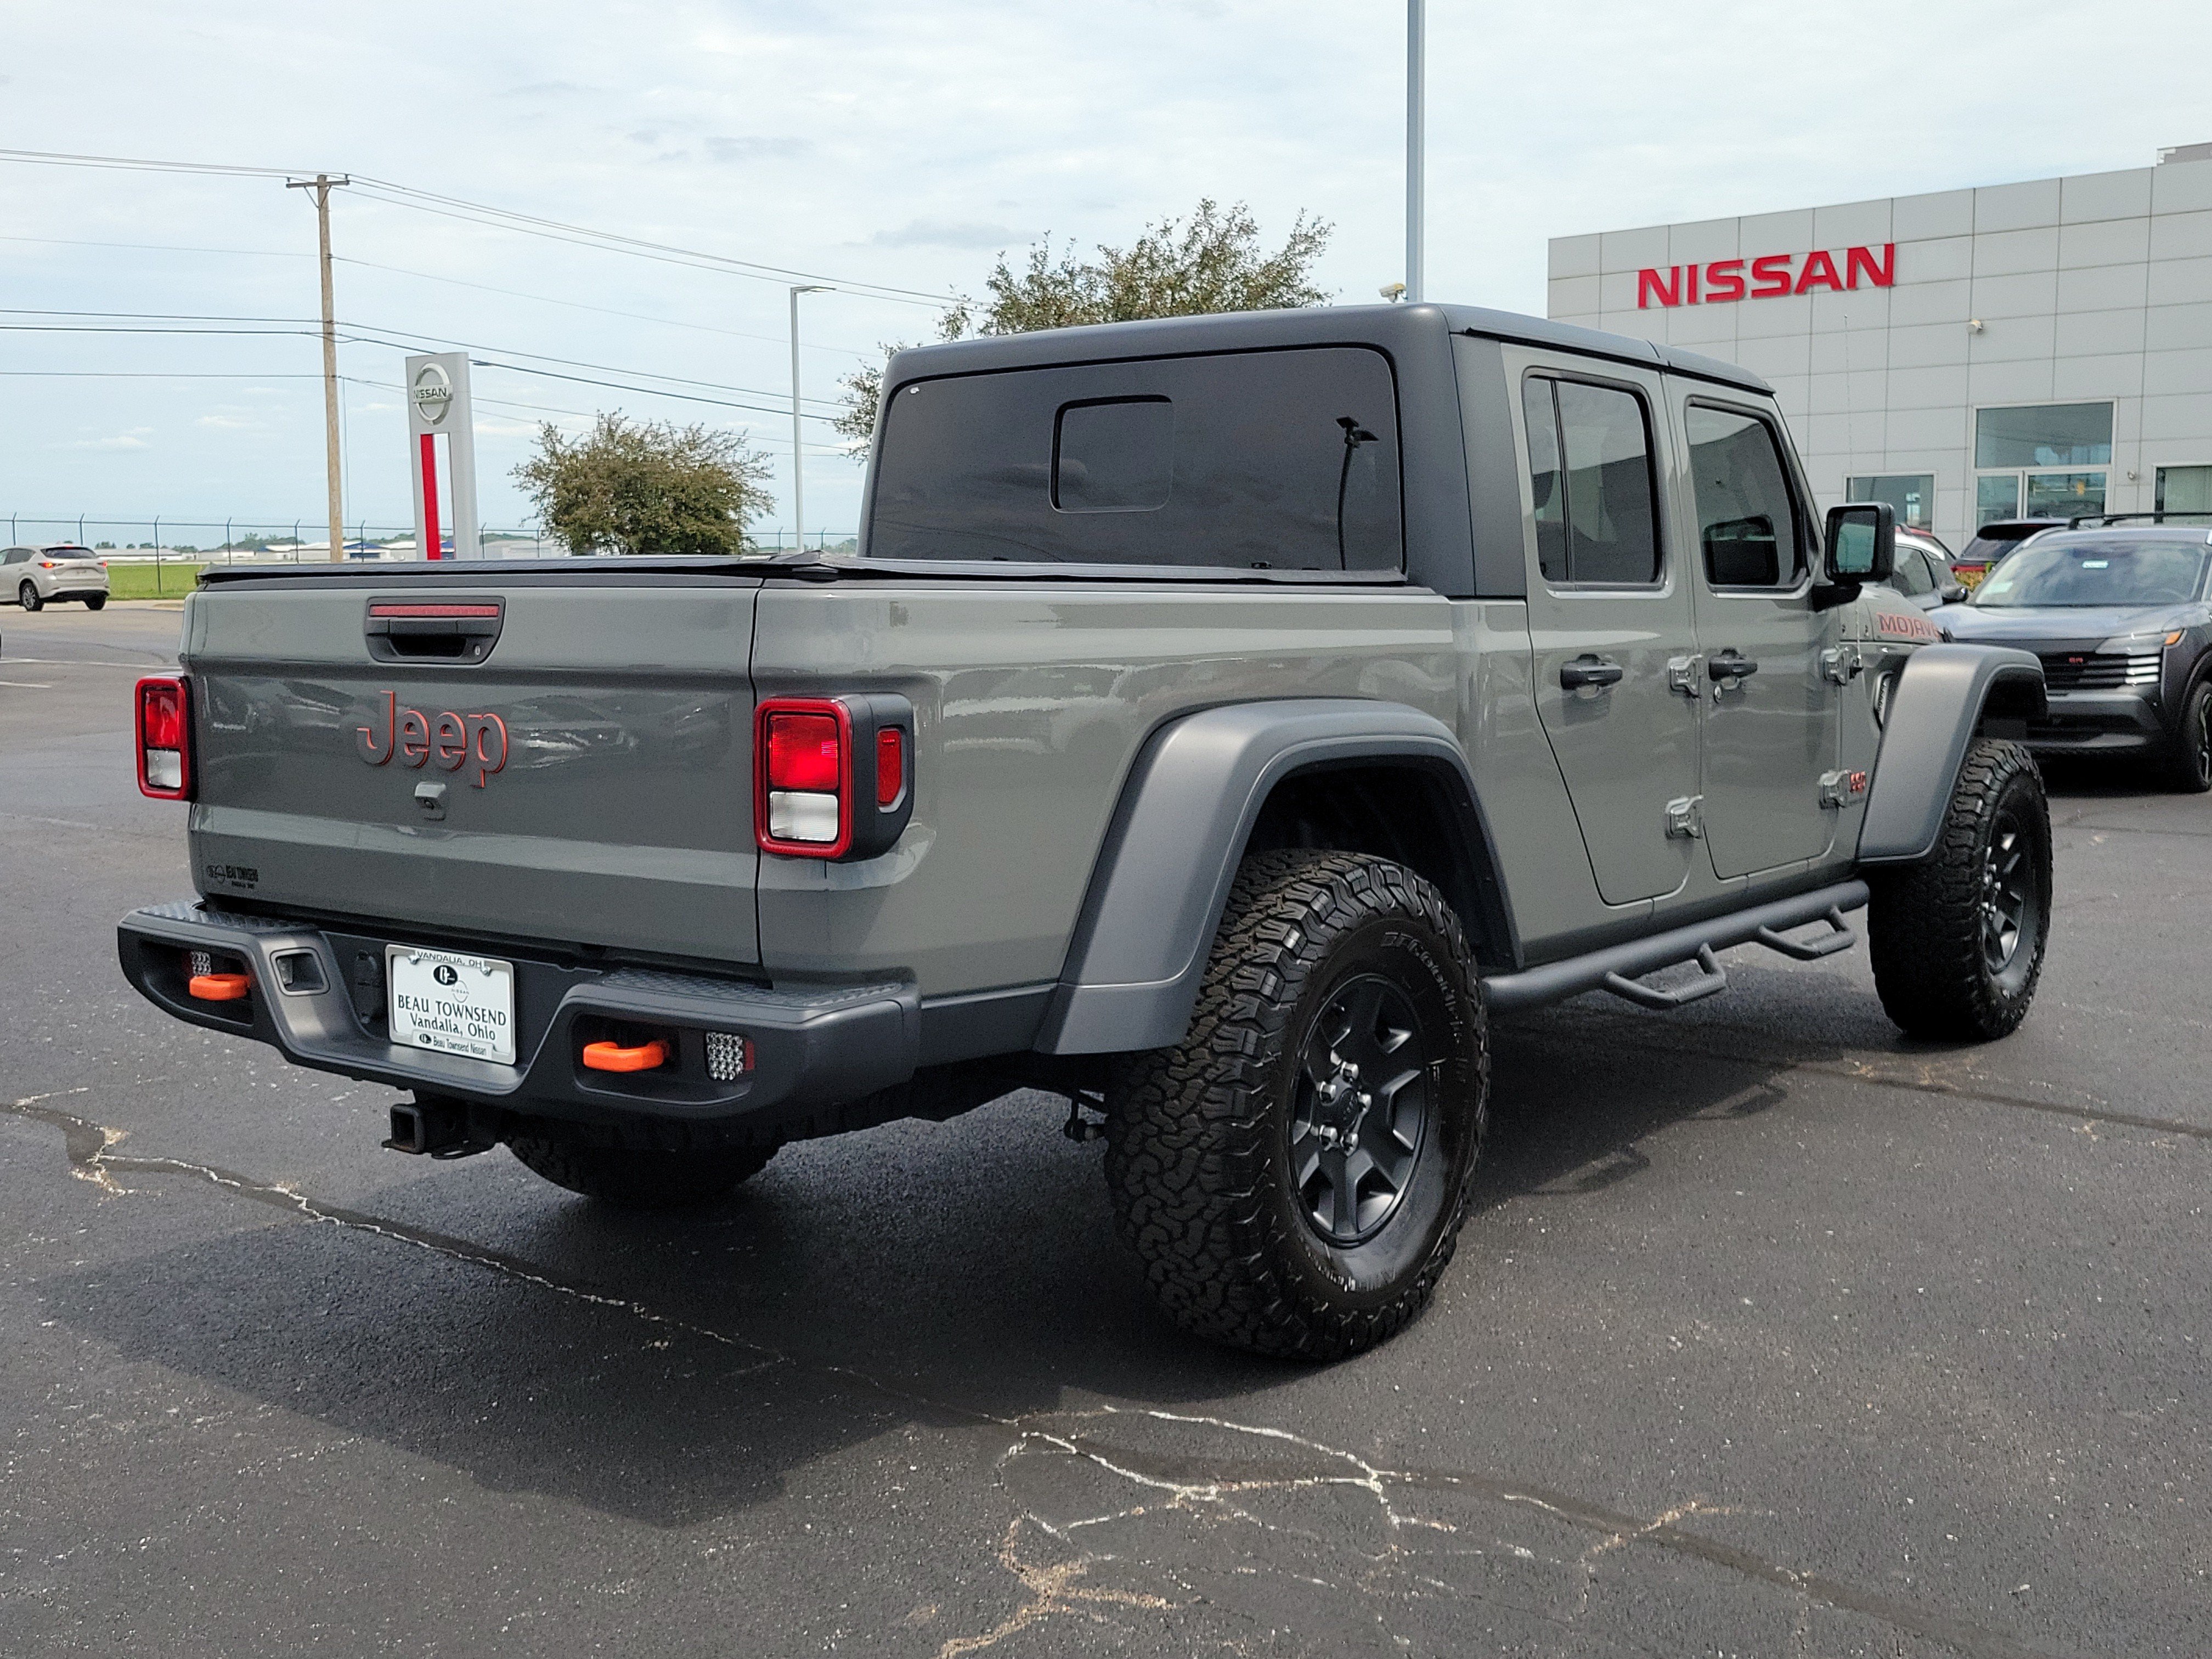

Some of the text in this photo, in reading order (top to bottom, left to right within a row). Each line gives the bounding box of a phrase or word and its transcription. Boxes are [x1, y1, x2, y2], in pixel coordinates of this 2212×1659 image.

[1638, 243, 1895, 309] NISSAN
[414, 387, 447, 399] NISSAN
[357, 690, 508, 788] Jeep
[417, 951, 482, 968] VANDALIA, OH
[398, 994, 506, 1026] BEAU TOWNSEND
[410, 1012, 496, 1040] Vandalia, Ohio
